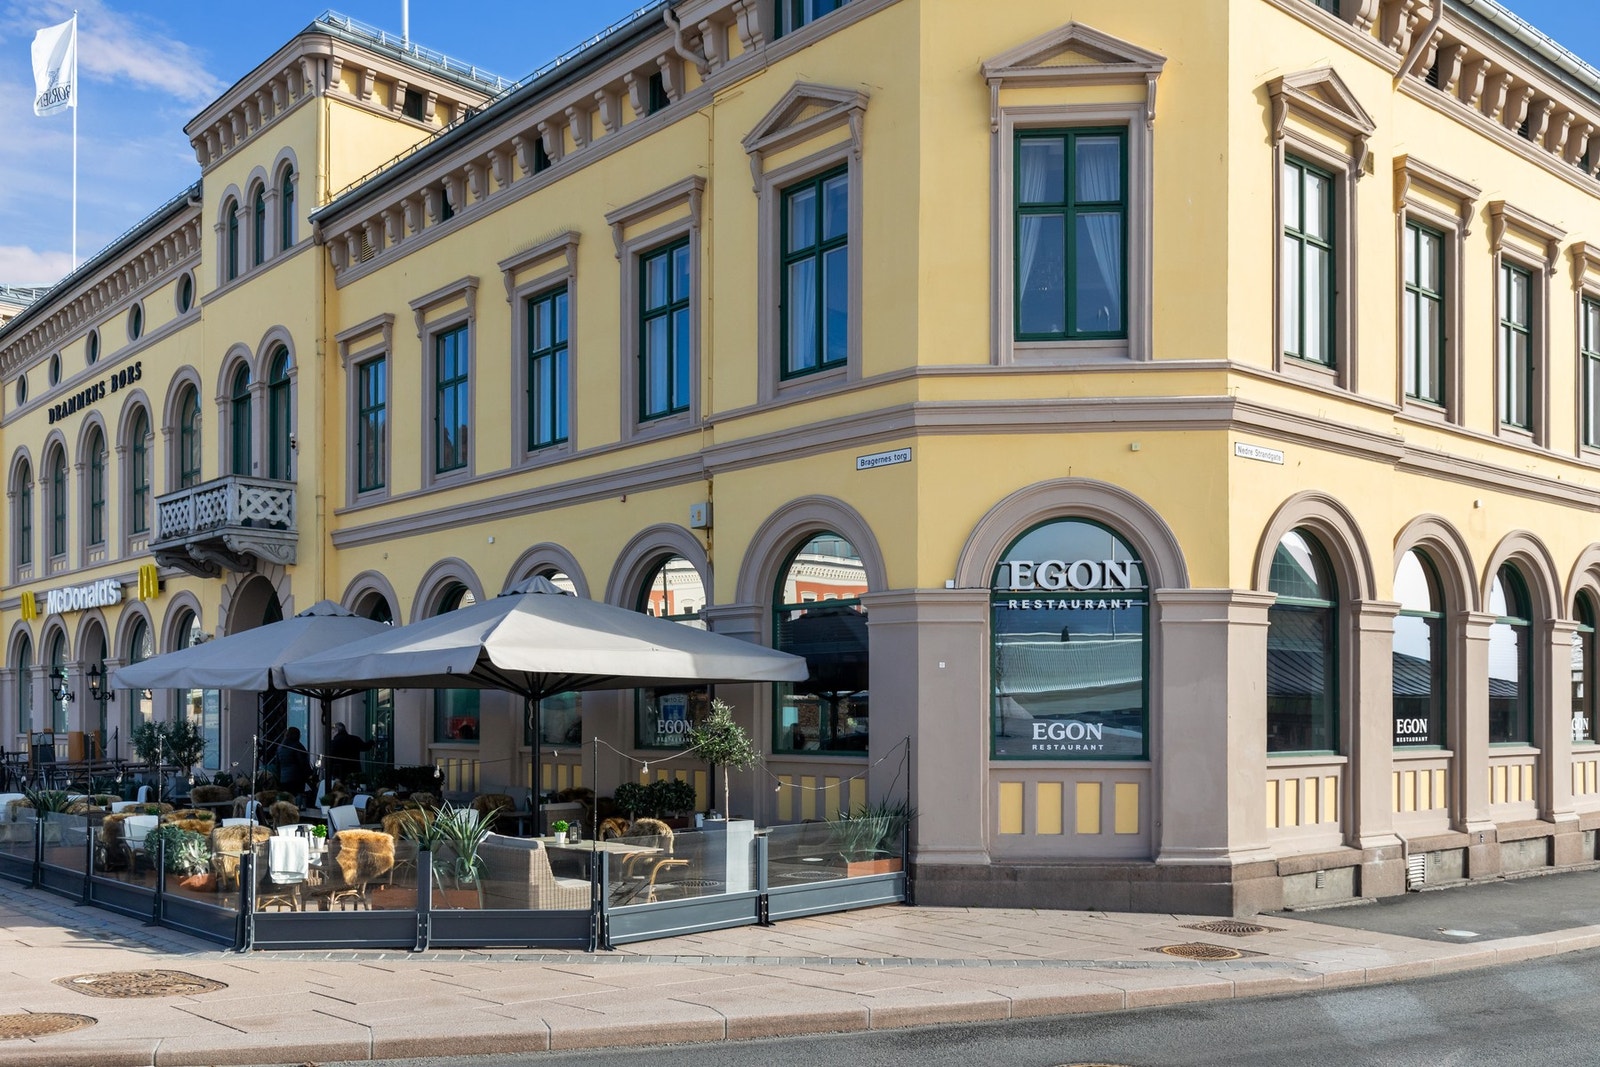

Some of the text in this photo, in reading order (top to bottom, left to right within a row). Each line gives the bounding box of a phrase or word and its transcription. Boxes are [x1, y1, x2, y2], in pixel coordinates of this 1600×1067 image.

[48, 361, 142, 425] DRAMMENS BØRS
[1237, 445, 1254, 456] Nedre
[860, 453, 908, 467] Bragernes torg
[1009, 559, 1134, 591] EGON
[47, 579, 122, 615] McDonald's
[1008, 599, 1133, 610] RESTAURANT
[657, 719, 693, 734] EGON
[1032, 722, 1104, 740] EGON
[1396, 718, 1428, 734] EGON
[1571, 717, 1589, 731] GON
